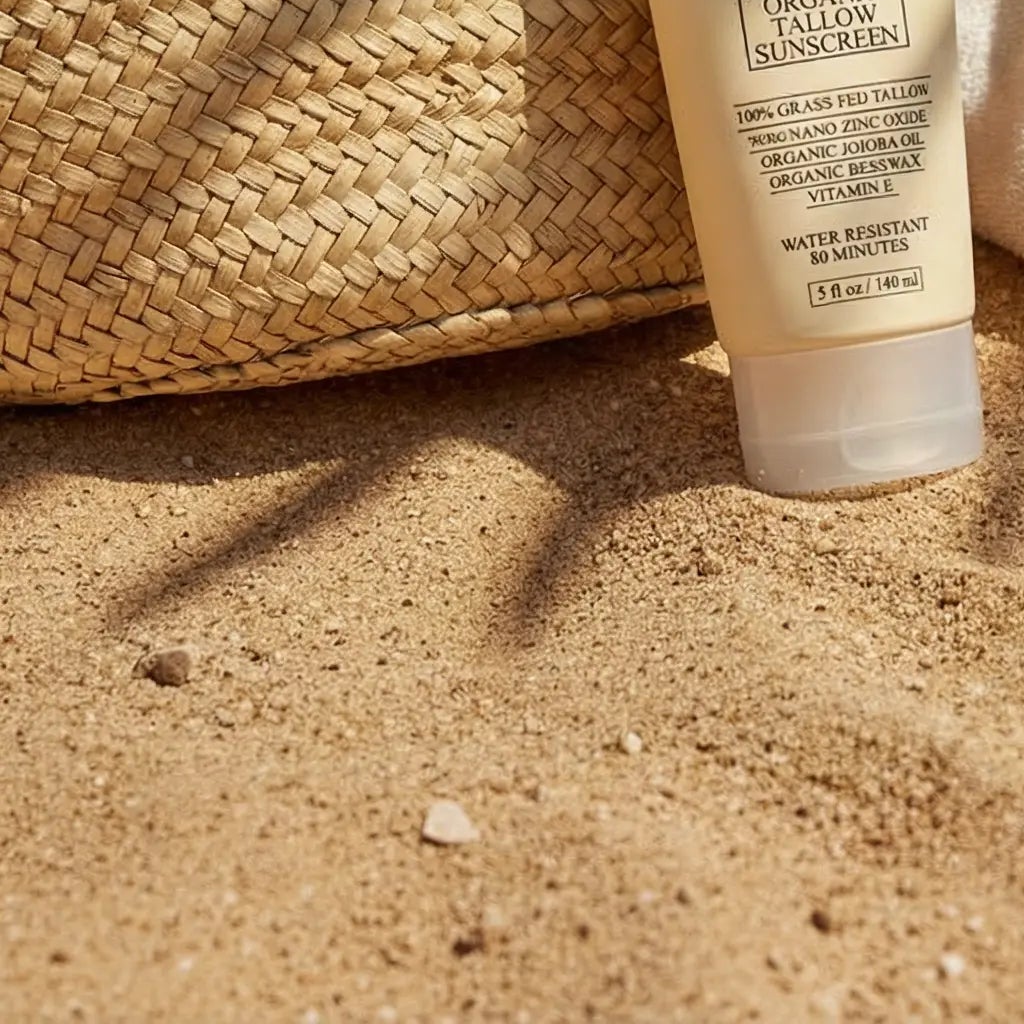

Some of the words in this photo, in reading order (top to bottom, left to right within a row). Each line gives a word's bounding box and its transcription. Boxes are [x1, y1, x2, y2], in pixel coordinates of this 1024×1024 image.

[770, 4, 877, 37] TALLOW
[755, 24, 899, 65] SUNSCREEN
[736, 105, 774, 124] 100%
[777, 97, 833, 117] GRASS
[837, 91, 868, 108] FED
[871, 83, 929, 103] TALLOW
[788, 122, 837, 141] NANO
[842, 115, 880, 134] ZINC
[883, 109, 928, 127] OXIDE
[760, 144, 838, 168] ORGANIC
[900, 132, 925, 147] OIL
[769, 164, 844, 189] ORGANIC
[807, 182, 879, 204] VITAMIN
[883, 178, 894, 193] E
[781, 230, 841, 253] WATER
[845, 217, 929, 243] RESISTANT
[810, 250, 829, 266] 80
[833, 238, 909, 262] MINUTES
[817, 285, 827, 300] 5
[830, 281, 842, 299] fl
[845, 282, 863, 296] oz
[875, 275, 900, 291] 140
[901, 271, 919, 287] ml
